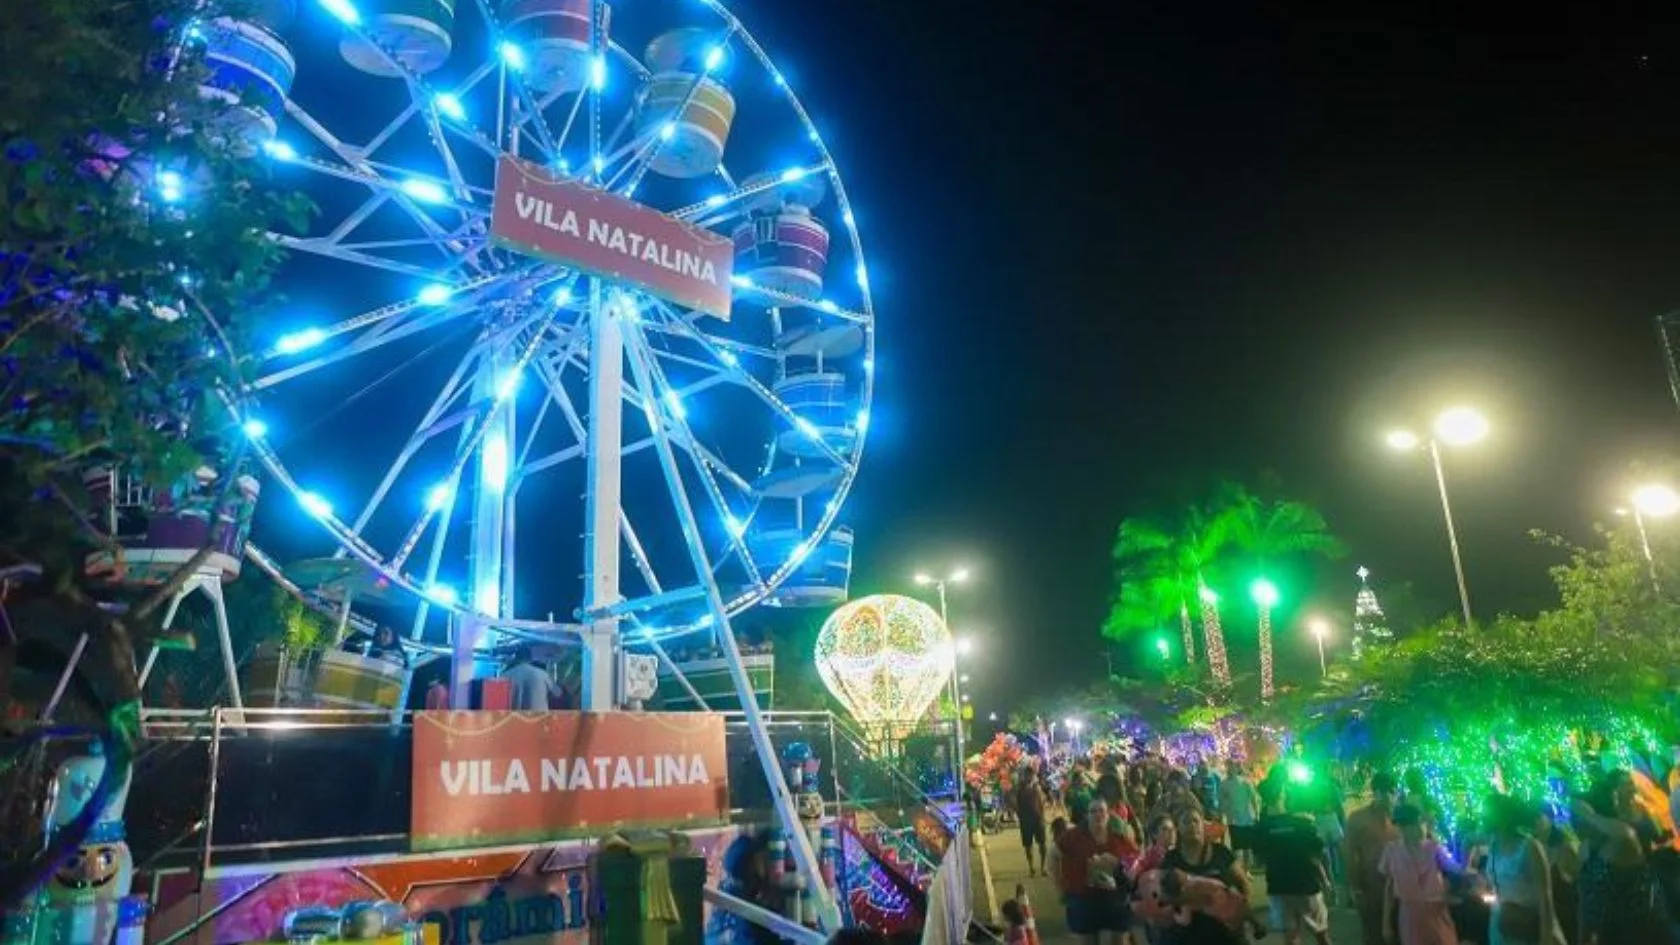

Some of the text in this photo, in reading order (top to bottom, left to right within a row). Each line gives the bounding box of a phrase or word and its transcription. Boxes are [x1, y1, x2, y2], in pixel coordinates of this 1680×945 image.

[515, 191, 717, 284] VILA NATALINA
[440, 753, 710, 795] VILA NATALINA
